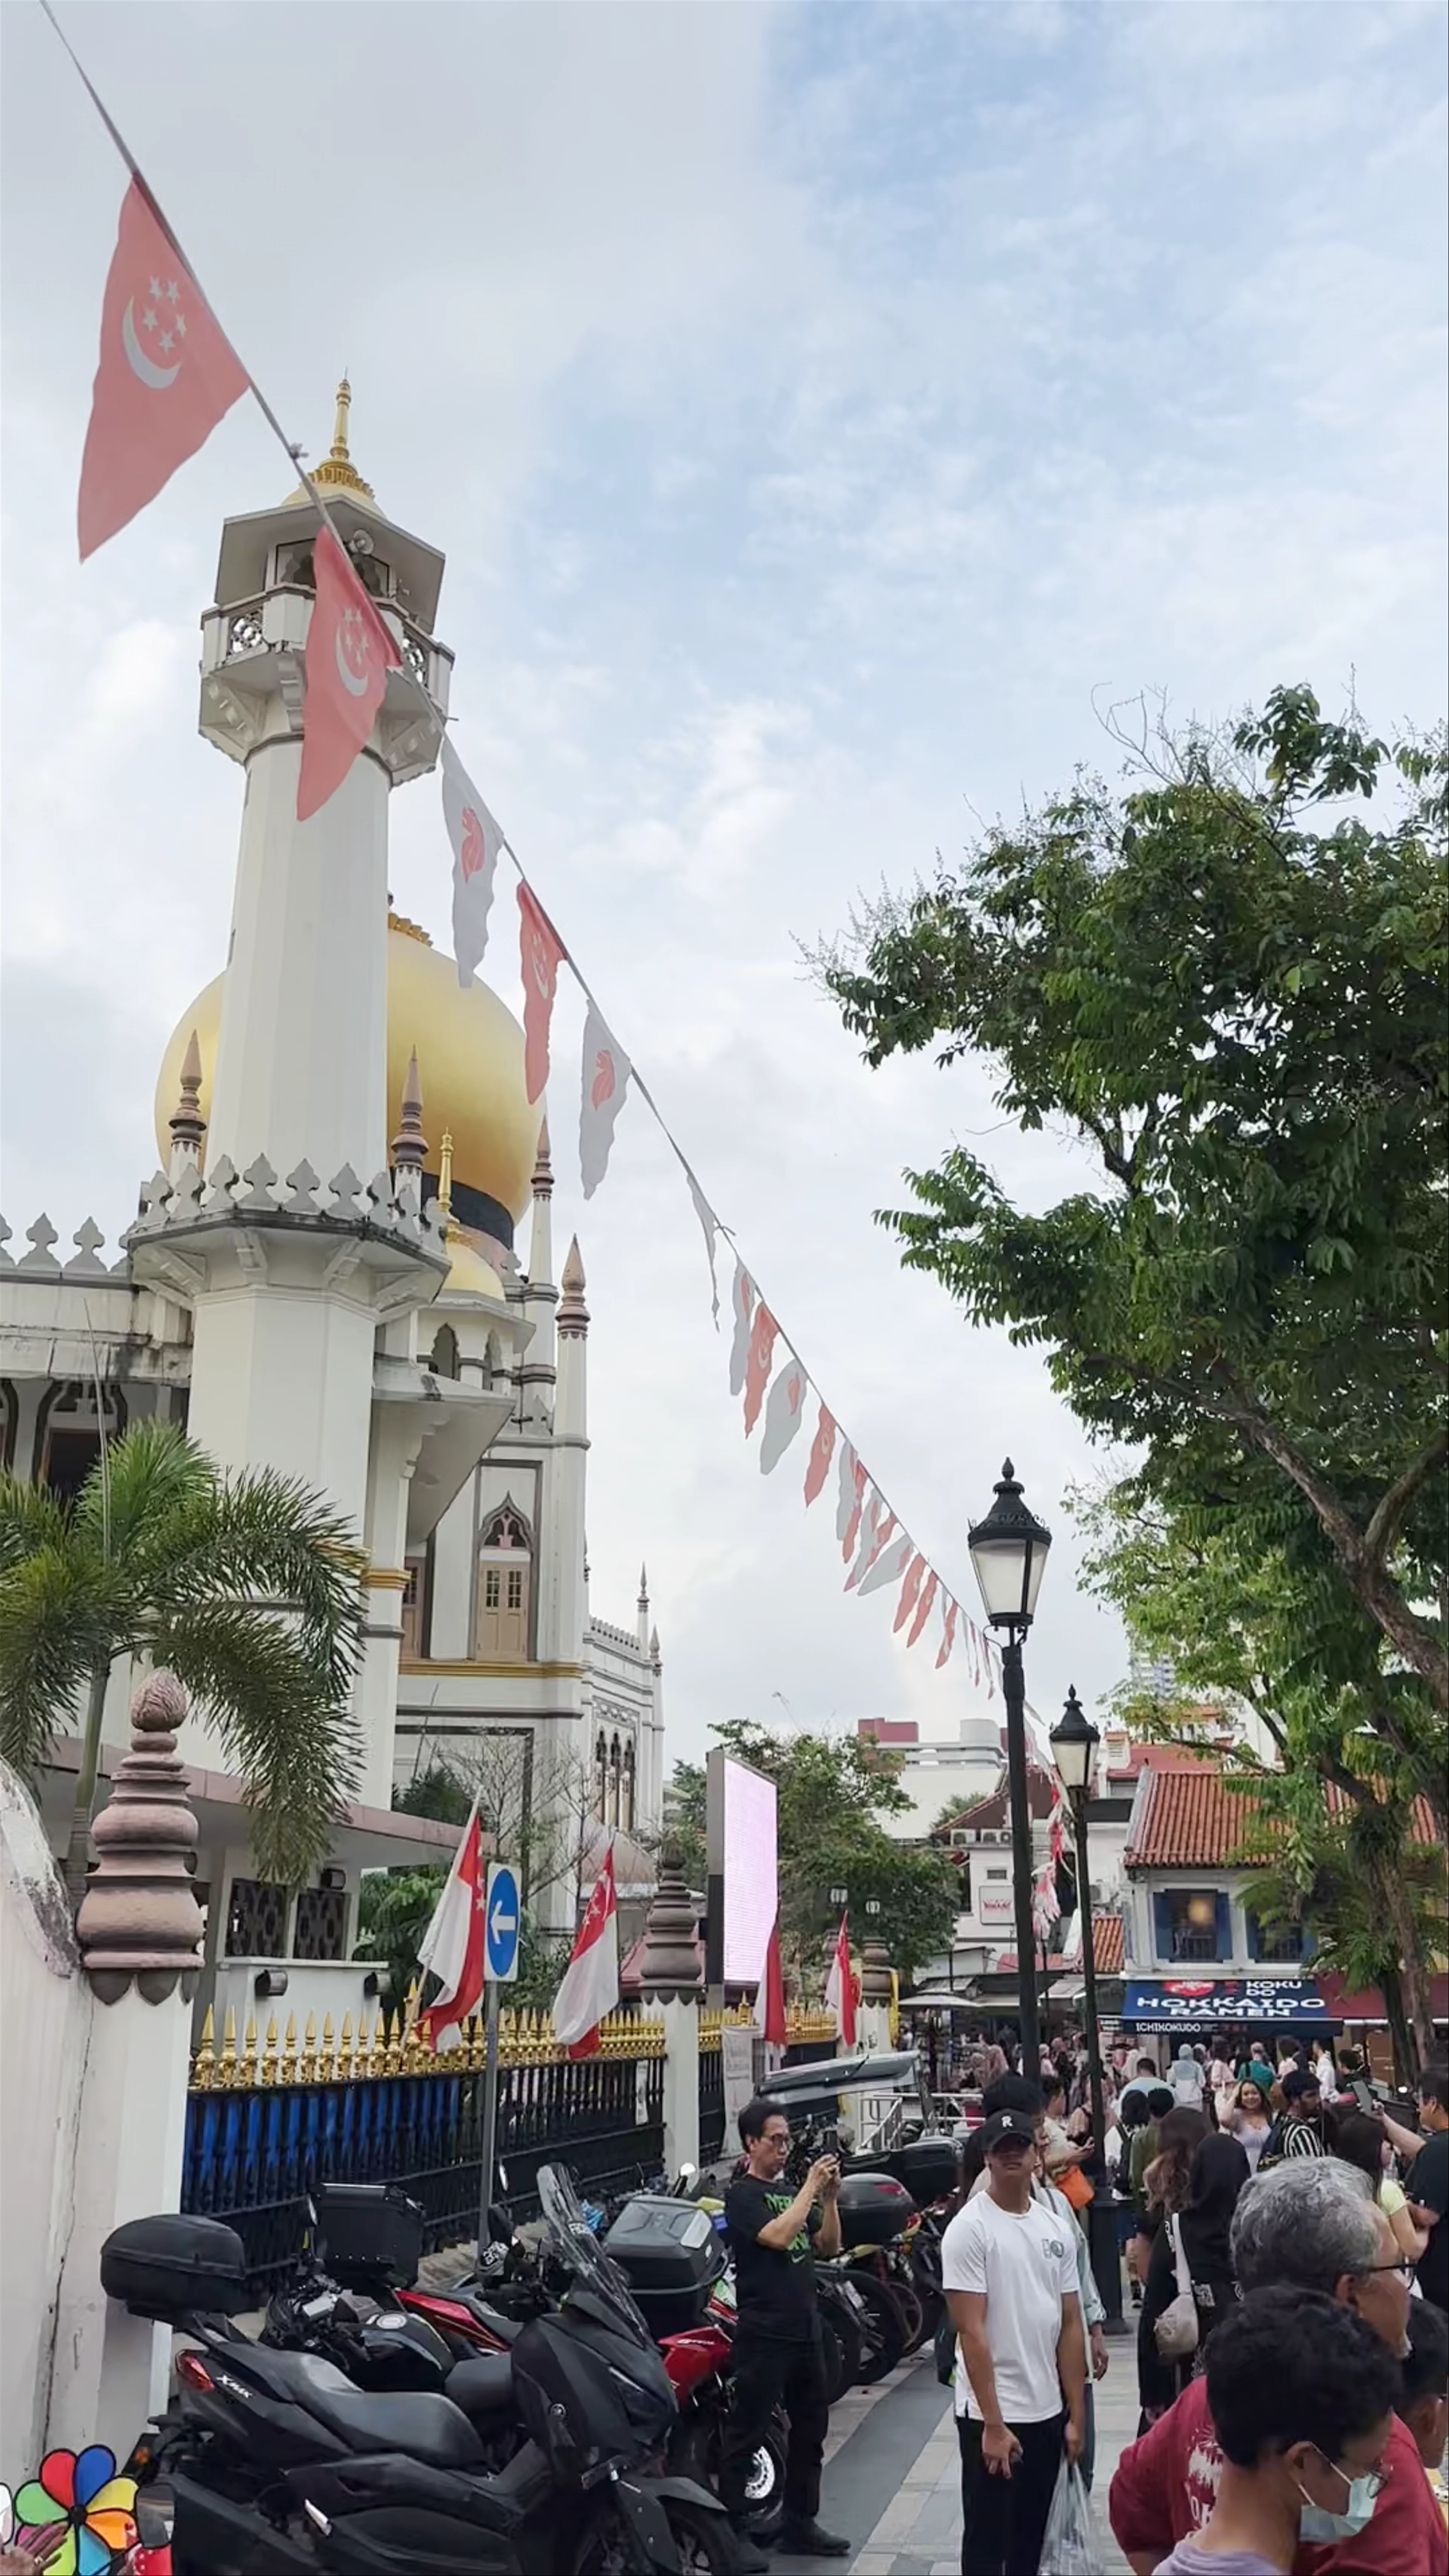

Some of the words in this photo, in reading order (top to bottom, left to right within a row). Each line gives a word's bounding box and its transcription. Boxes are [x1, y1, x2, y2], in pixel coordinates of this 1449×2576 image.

[1246, 1981, 1302, 1989] KOKU
[1137, 1997, 1325, 2008] HOKKAIDO
[1170, 2007, 1291, 2016] RAMEN
[1135, 2022, 1201, 2032] ICHIKOKUDO
[1001, 2115, 1013, 2128] R
